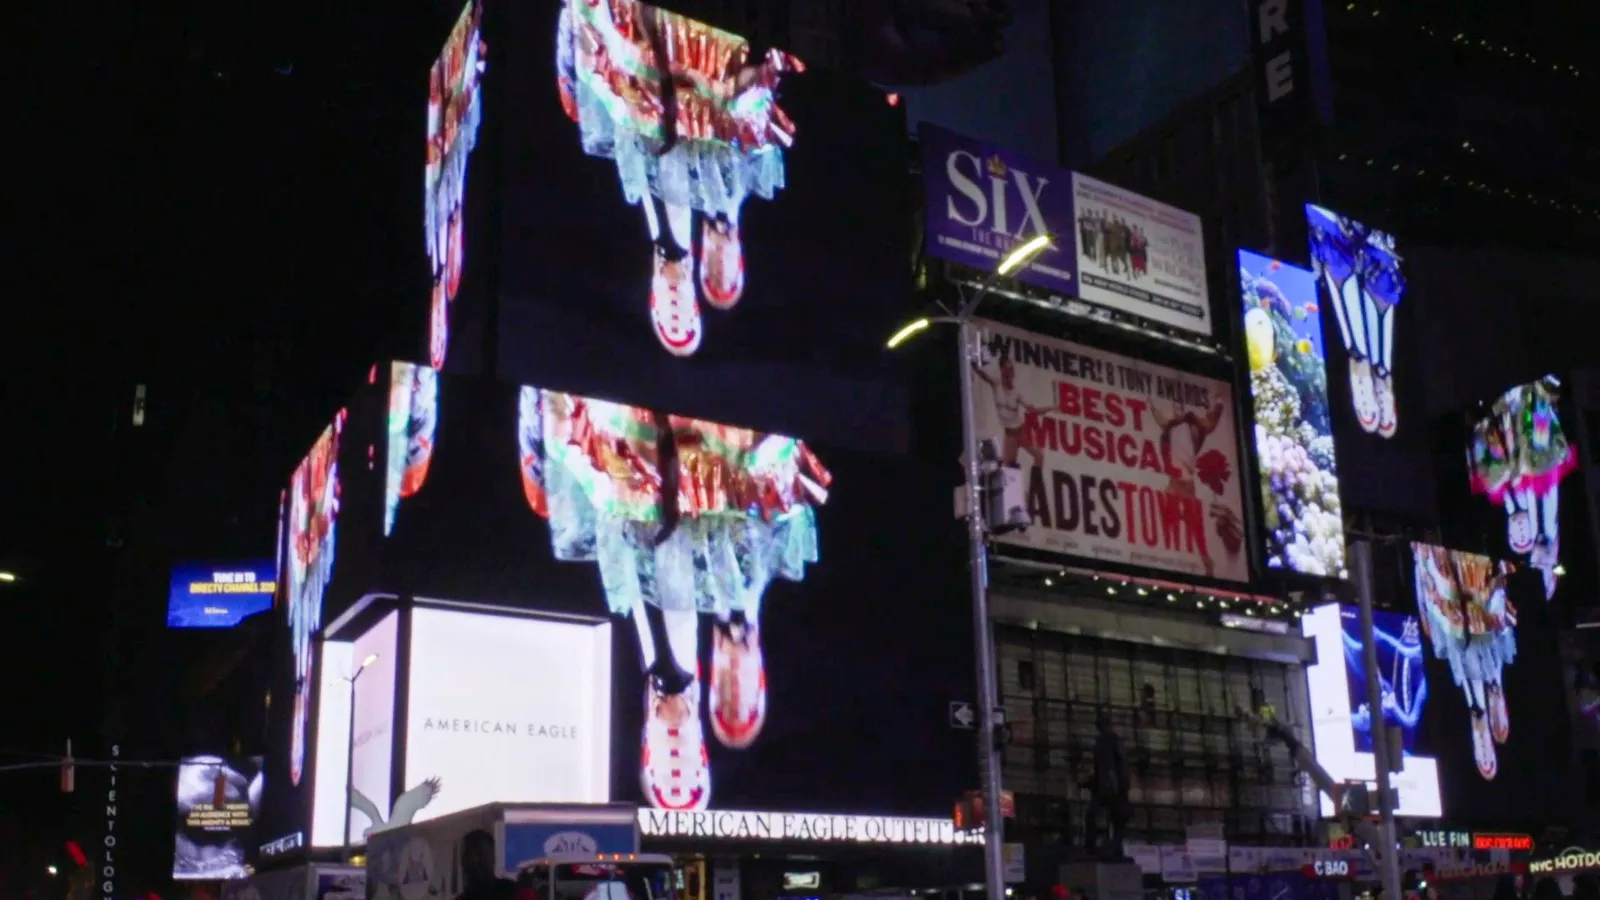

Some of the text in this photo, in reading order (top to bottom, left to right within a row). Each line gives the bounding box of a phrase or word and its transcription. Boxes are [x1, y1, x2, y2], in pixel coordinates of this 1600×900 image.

[946, 149, 1059, 253] SIX
[982, 332, 1210, 410] WINNER! 8 TONY AWARDS
[1058, 381, 1147, 432] BEST
[1024, 408, 1184, 478] MUSICAL
[1026, 465, 1208, 556] ADESTOWN
[424, 717, 578, 739] AMERICAN EAGLE
[102, 744, 120, 900] SCIENTOLOG
[648, 810, 970, 843] MERICAN EAGLE OUTFIT
[1415, 830, 1447, 847] LUE
[1450, 831, 1470, 848] FIN
[1325, 860, 1349, 876] BAO
[1530, 859, 1554, 873] NYC
